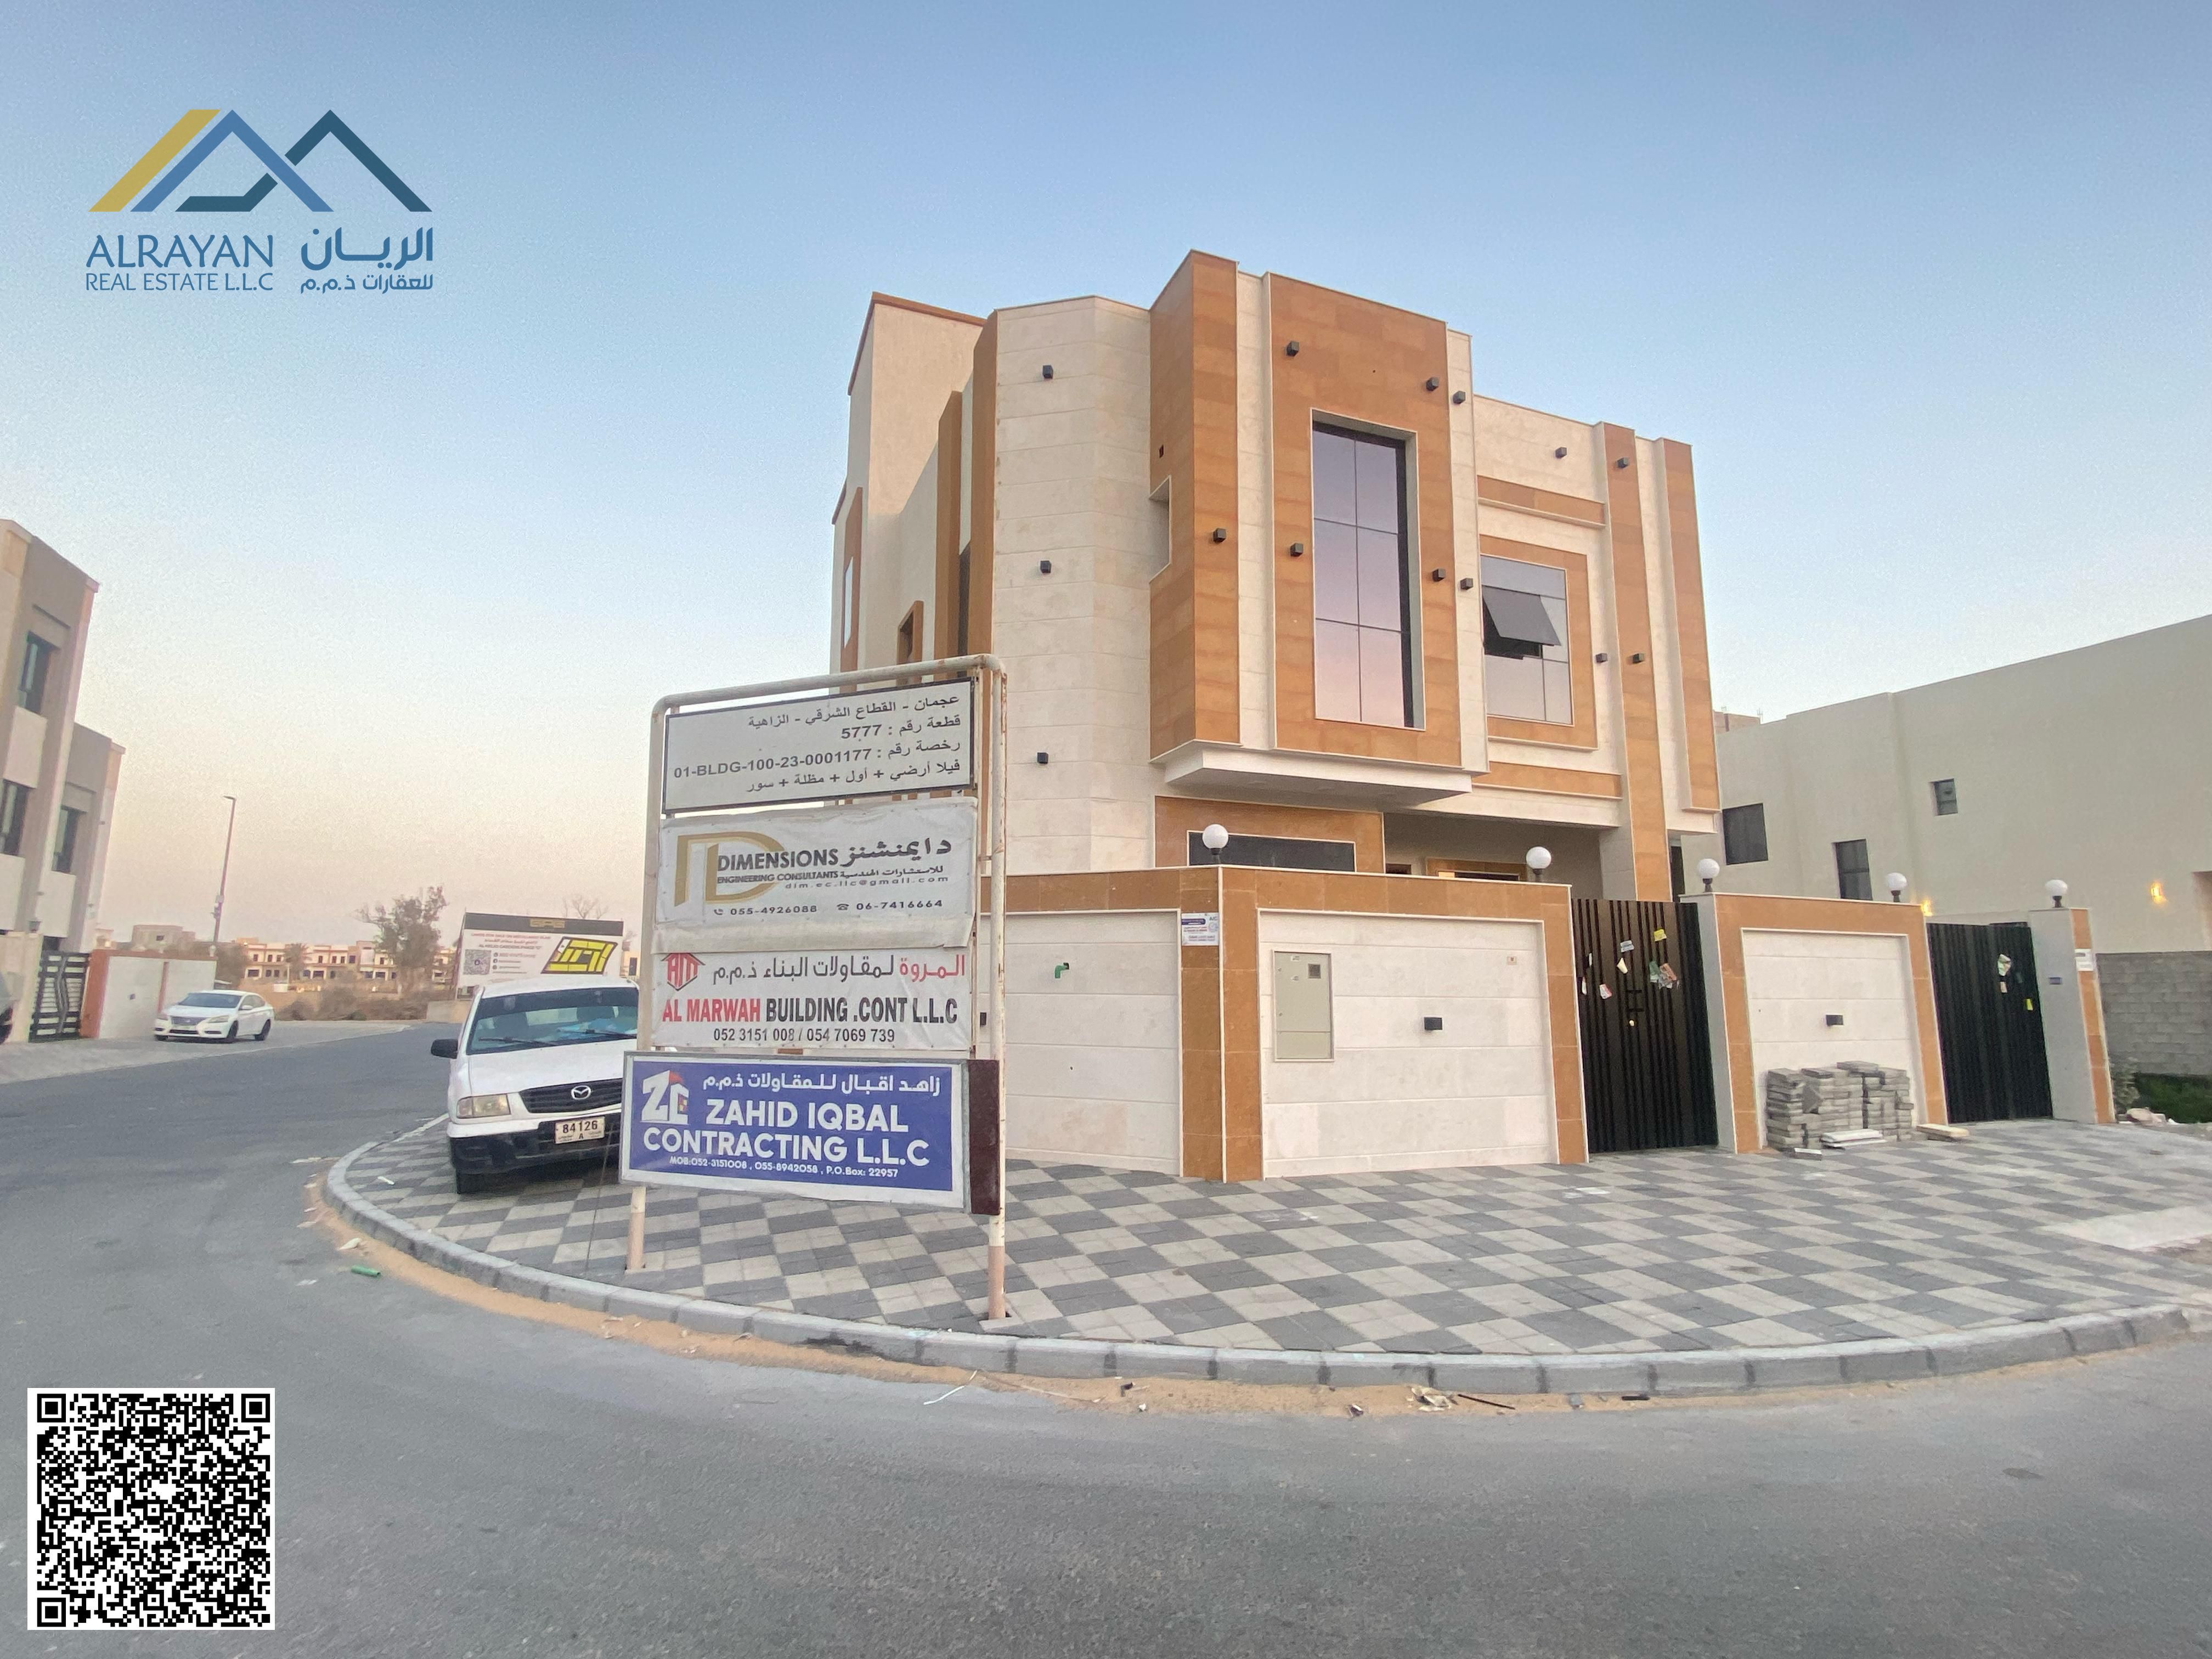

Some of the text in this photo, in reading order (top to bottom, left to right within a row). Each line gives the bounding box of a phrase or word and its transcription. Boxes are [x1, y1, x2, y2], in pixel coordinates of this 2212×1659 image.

[855, 701, 896, 720] القطاع
[914, 696, 960, 711] عجمان
[748, 714, 789, 730] الزاهية
[805, 707, 850, 726] الشرقي
[927, 715, 961, 729] قطعة
[840, 724, 883, 739] 5777
[899, 719, 922, 736] رقم
[888, 743, 911, 760] رقم
[915, 740, 961, 752] رخصة
[674, 749, 872, 778] 01-BLDG-100-23-0001177
[936, 759, 960, 774] فيلا
[845, 768, 867, 783] أول
[890, 761, 930, 782] أرضي
[746, 782, 774, 792] سور
[794, 774, 825, 785] مظلة
[718, 849, 839, 871] DIMENSIONS
[717, 871, 839, 884] ENGINEERING CONSULTANTS
[839, 865, 944, 879] للاستشارات الهندسية
[730, 905, 817, 916] 055-4926088
[856, 900, 943, 911] 06-7416664
[713, 954, 966, 985] المروة لمقاولات البناء ذ.م.م
[662, 997, 958, 1024] AL MARWAH BUILDING .CONT L.L.C
[714, 1028, 736, 1041] 052
[739, 1028, 768, 1041] 3151
[772, 1029, 795, 1041] 008
[806, 1029, 830, 1042] 054
[834, 1028, 866, 1042] 7069
[870, 1029, 895, 1042] 739
[703, 1073, 940, 1097] زاهد اقبال للمقاولات ذ.م.م
[706, 1099, 909, 1133] ZAHID IQBAL
[562, 1120, 598, 1133] 84126
[644, 1127, 930, 1166] CONTRACTING L.L.C
[754, 1161, 818, 1174] 055-8942058
[868, 1167, 899, 1178] 22957
